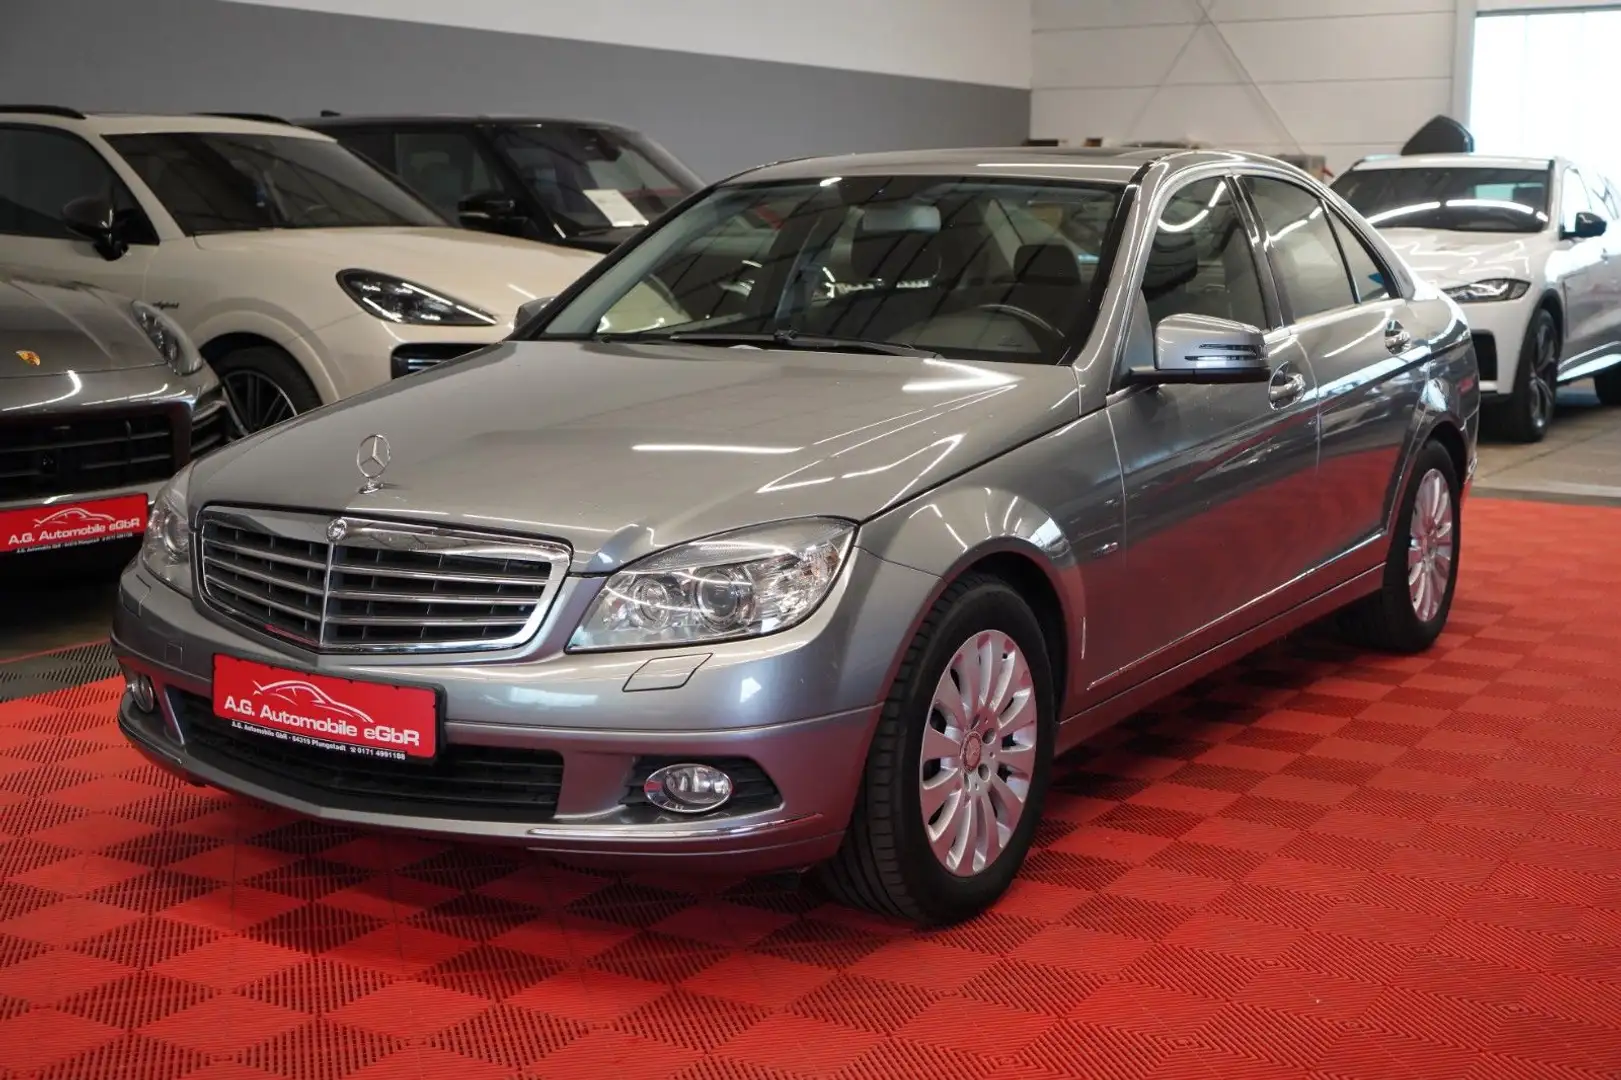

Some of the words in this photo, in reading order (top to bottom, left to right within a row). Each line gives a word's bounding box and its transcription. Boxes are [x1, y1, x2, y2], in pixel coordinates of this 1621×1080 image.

[8, 532, 35, 545] A.G.
[40, 523, 106, 541] Automobile
[109, 518, 141, 532] eGbR
[223, 695, 256, 717] A.G.
[260, 704, 358, 737] Automobile
[363, 725, 420, 747] eGbR
[231, 720, 243, 729] A.G.
[244, 724, 275, 737] Automobile
[275, 731, 288, 740] GbR
[357, 746, 374, 756] 0171
